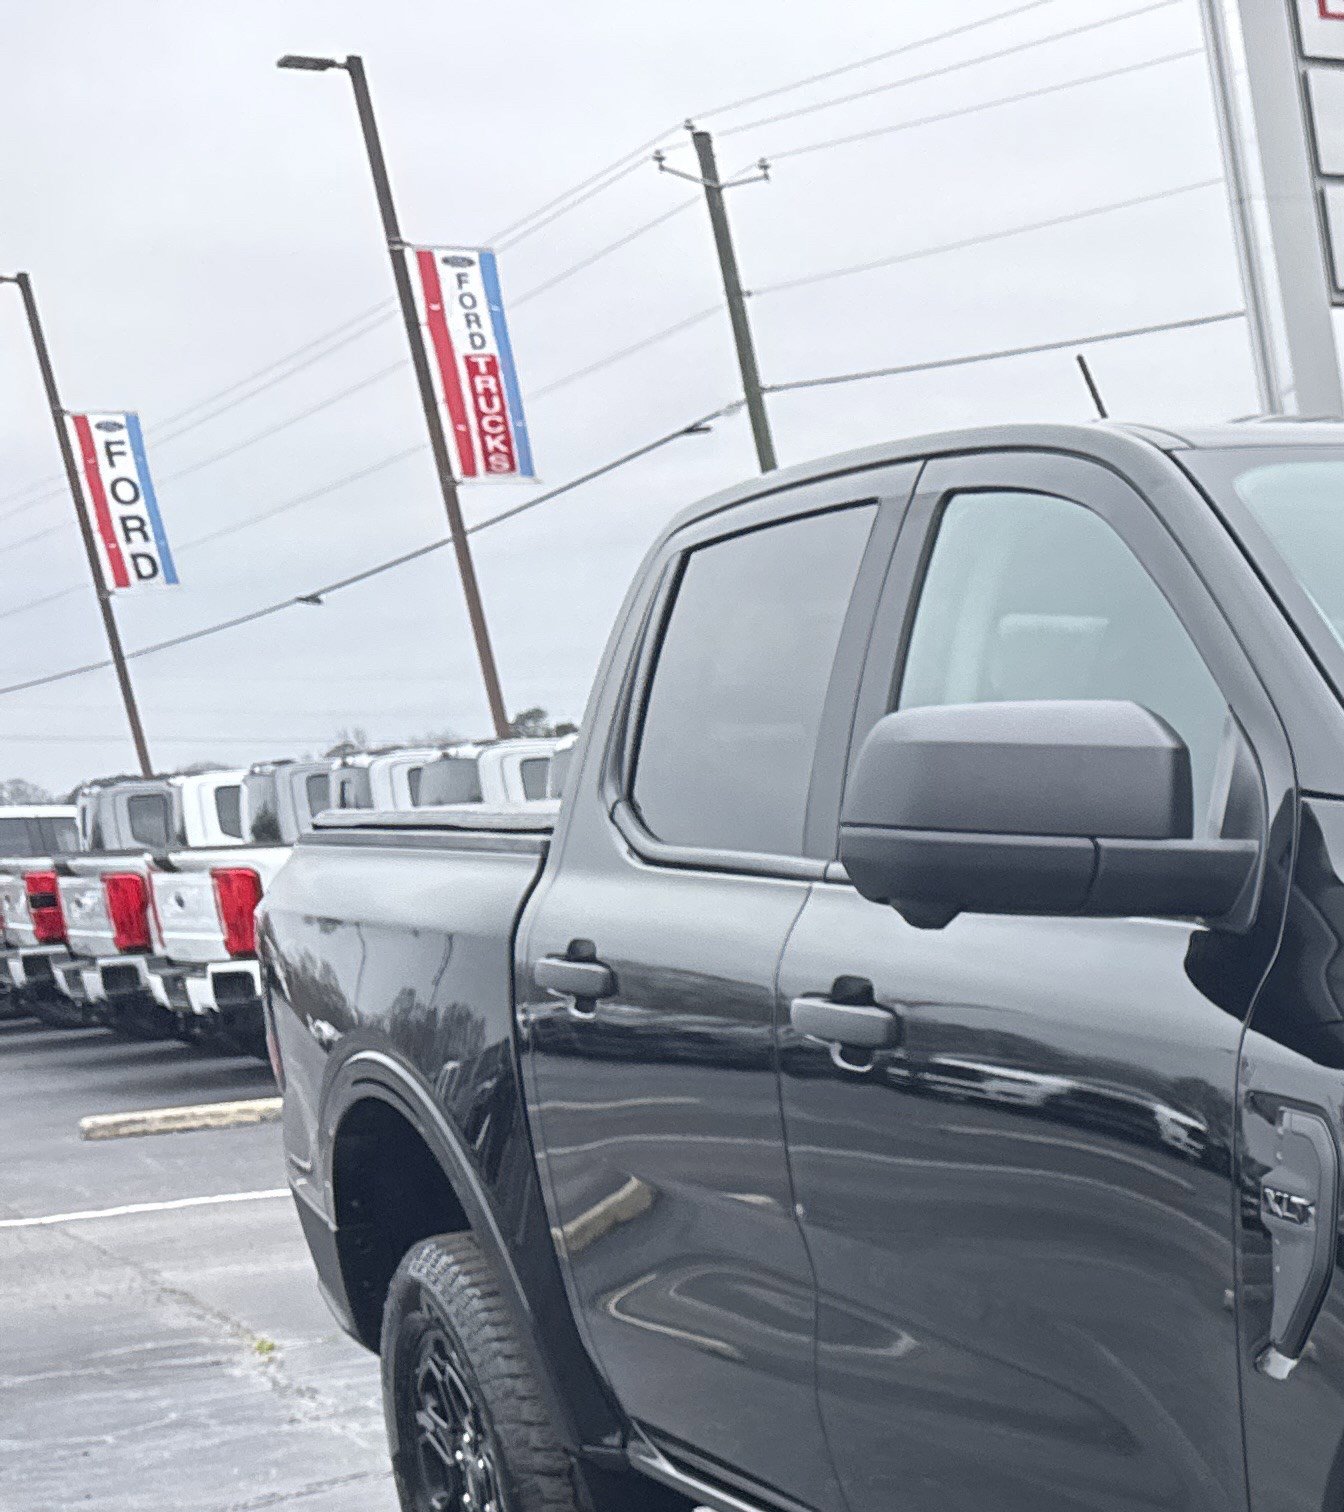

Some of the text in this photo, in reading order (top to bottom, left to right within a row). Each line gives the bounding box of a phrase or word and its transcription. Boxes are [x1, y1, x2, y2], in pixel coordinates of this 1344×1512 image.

[456, 272, 487, 350] FORD
[469, 356, 510, 474] TRUCKS
[104, 439, 159, 581] FORD
